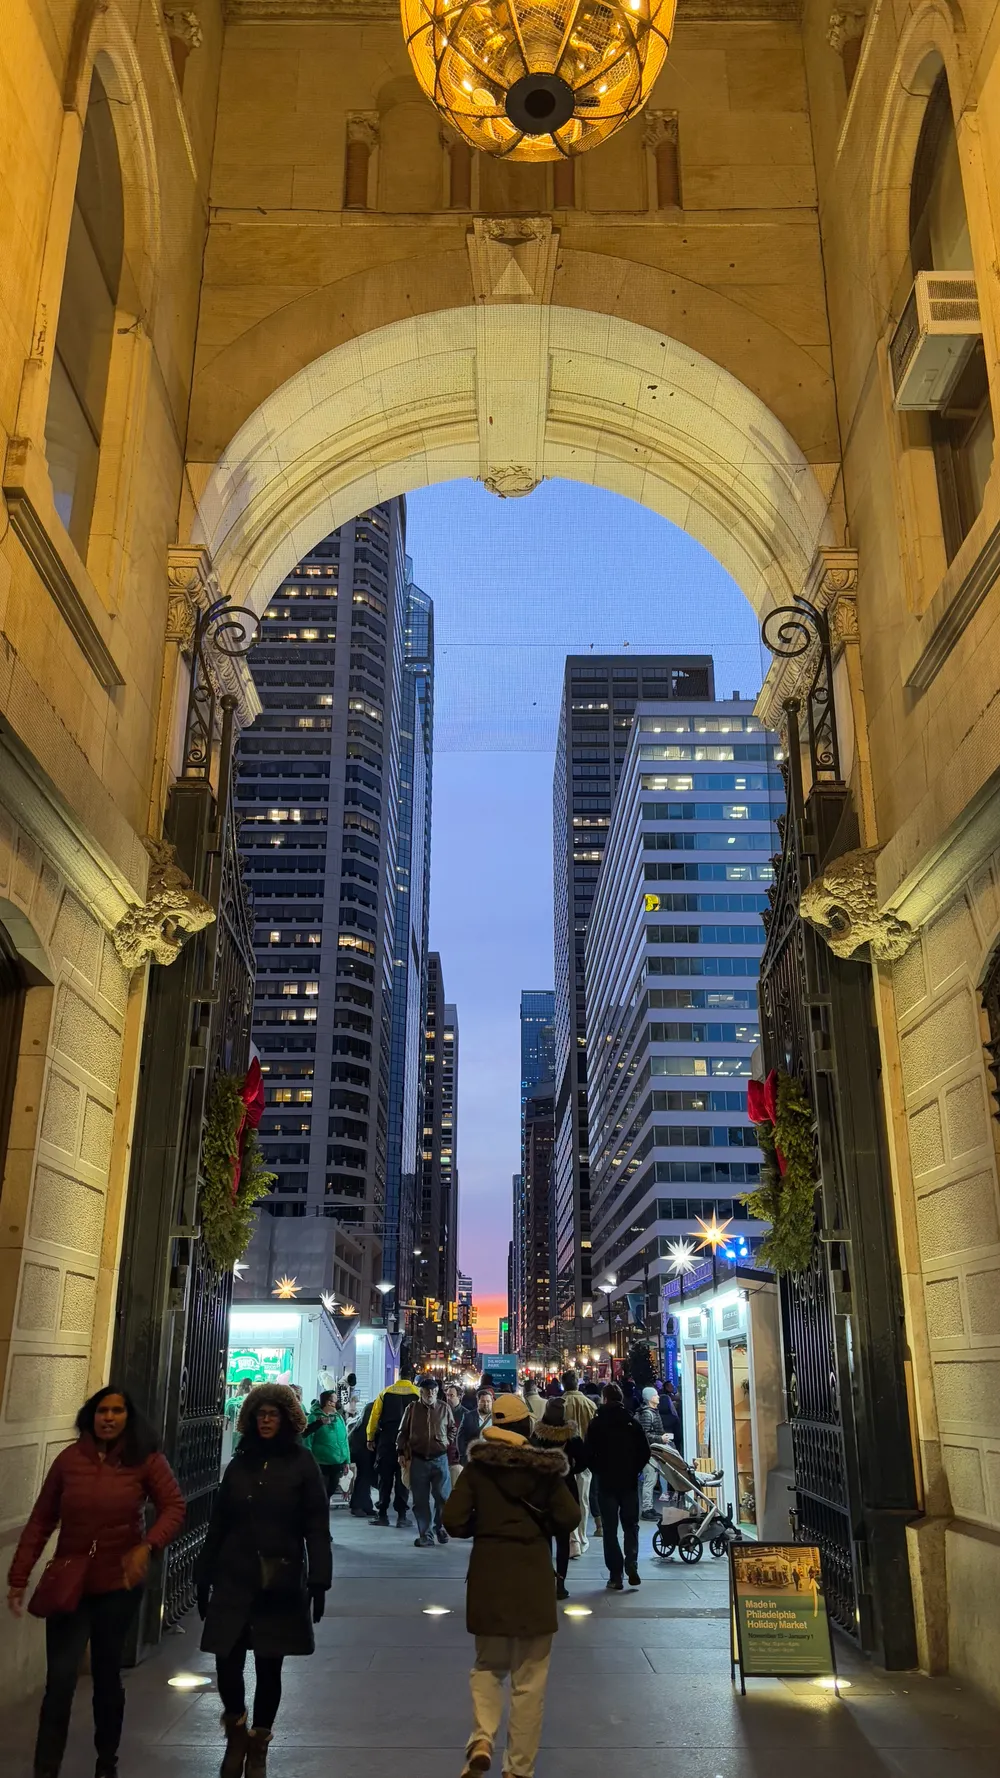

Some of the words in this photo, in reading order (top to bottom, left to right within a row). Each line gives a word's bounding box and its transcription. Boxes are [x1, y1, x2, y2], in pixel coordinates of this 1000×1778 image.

[745, 1600, 768, 1608] Made
[769, 1600, 777, 1608] in
[746, 1610, 796, 1620] Philadelphia
[747, 1620, 778, 1630] Holiday
[779, 1621, 808, 1629] Market
